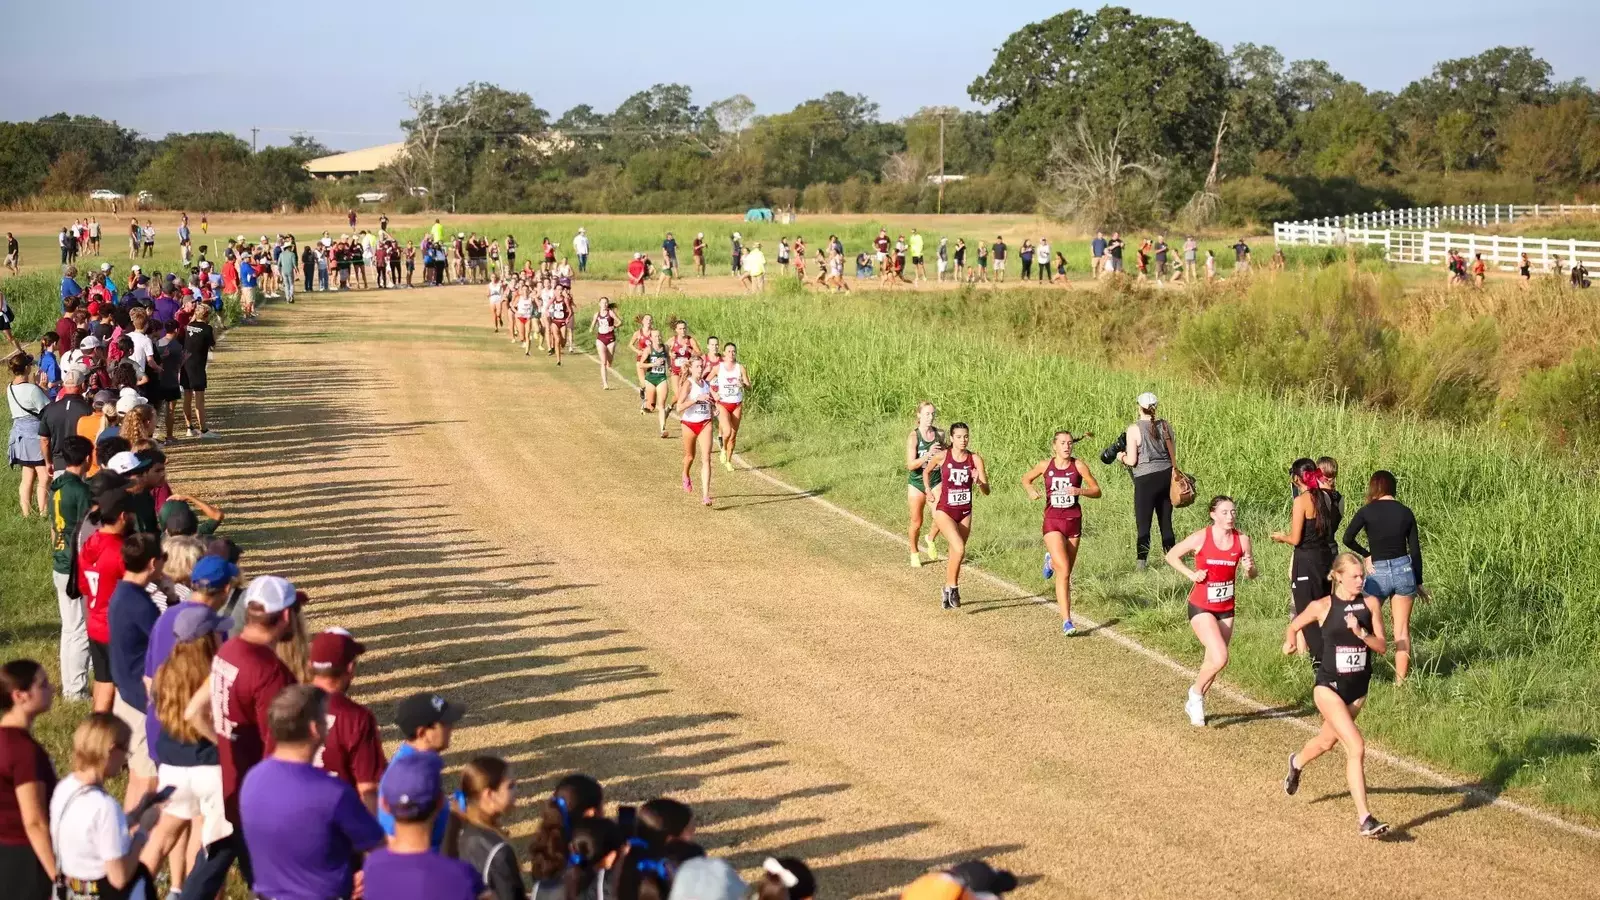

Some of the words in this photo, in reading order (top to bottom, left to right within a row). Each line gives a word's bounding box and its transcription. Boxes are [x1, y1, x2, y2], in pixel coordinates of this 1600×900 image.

[953, 493, 967, 502] 128
[1055, 495, 1071, 504] 134
[1215, 587, 1228, 598] 27
[1346, 654, 1361, 666] 42
